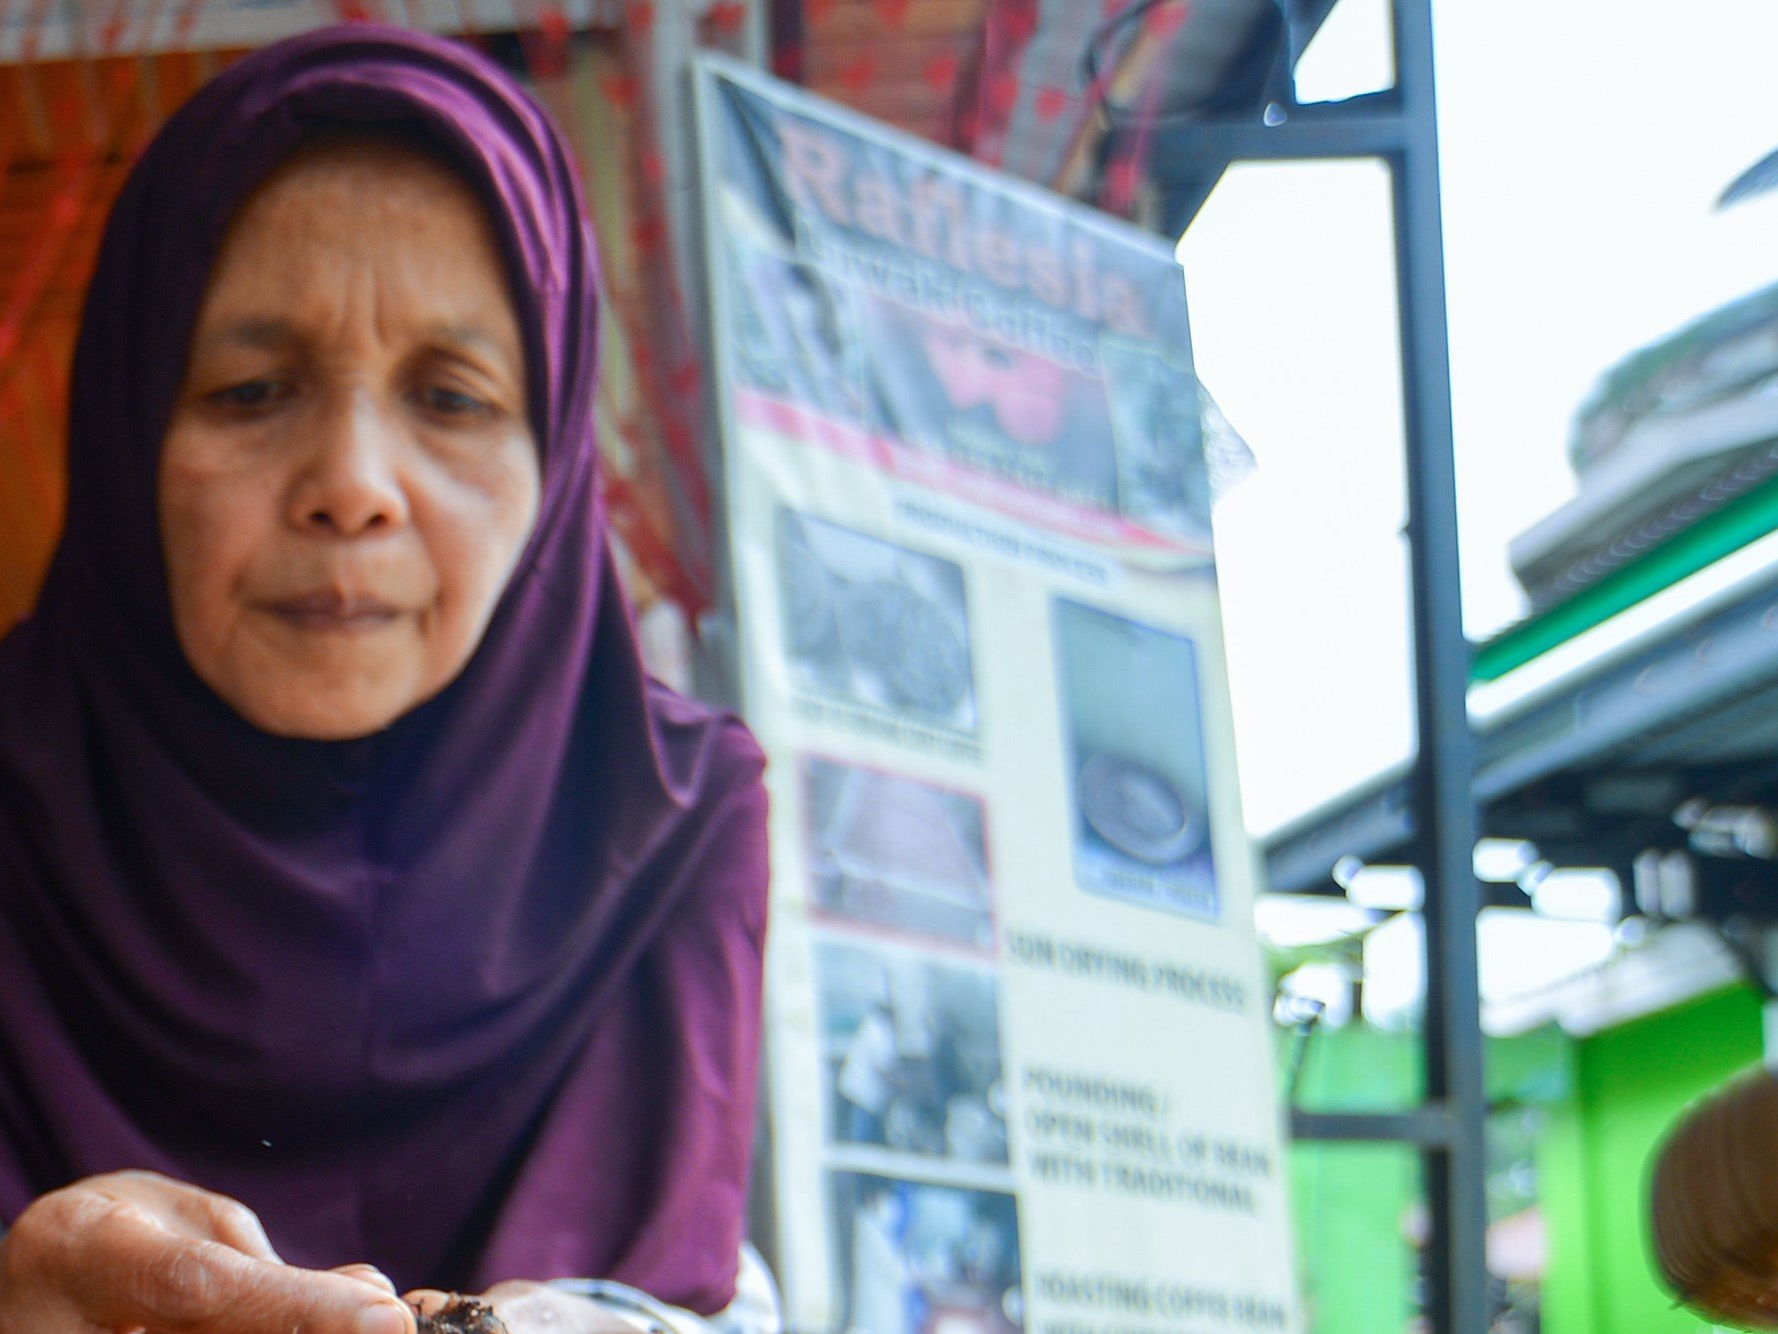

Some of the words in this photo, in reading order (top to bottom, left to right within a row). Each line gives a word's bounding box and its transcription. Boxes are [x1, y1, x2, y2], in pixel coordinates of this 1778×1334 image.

[1059, 938, 1149, 991] DRYING
[1151, 958, 1247, 1012] PROCESS
[1023, 1064, 1158, 1118] POUNDING
[1030, 1149, 1096, 1186] WITH
[1101, 1159, 1258, 1215] TRADITIONAL
